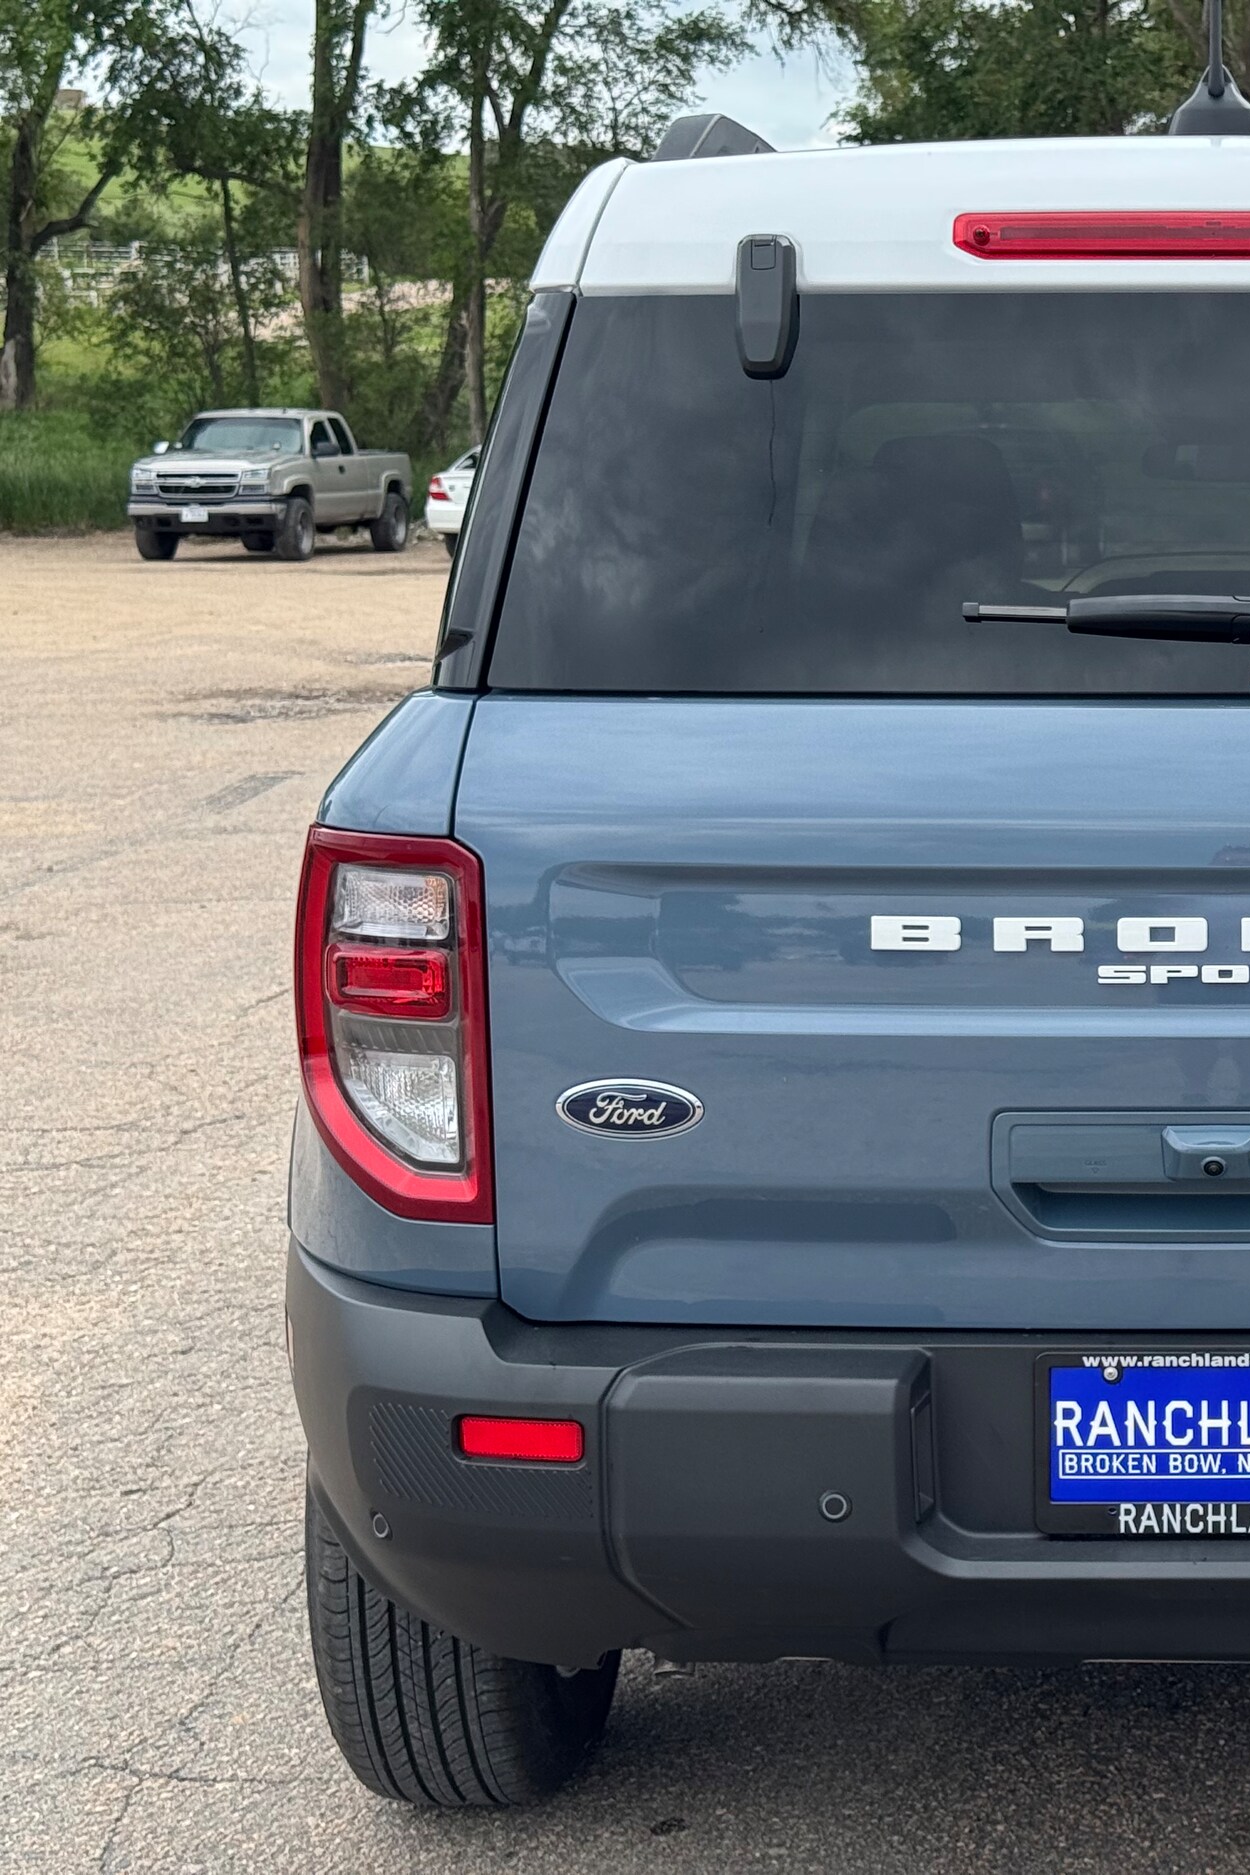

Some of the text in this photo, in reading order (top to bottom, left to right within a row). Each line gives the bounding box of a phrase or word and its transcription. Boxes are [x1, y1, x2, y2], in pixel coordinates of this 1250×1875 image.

[589, 1091, 667, 1125] Ford
[1065, 1454, 1156, 1474] BROKEN
[1169, 1454, 1227, 1475] BOW,
